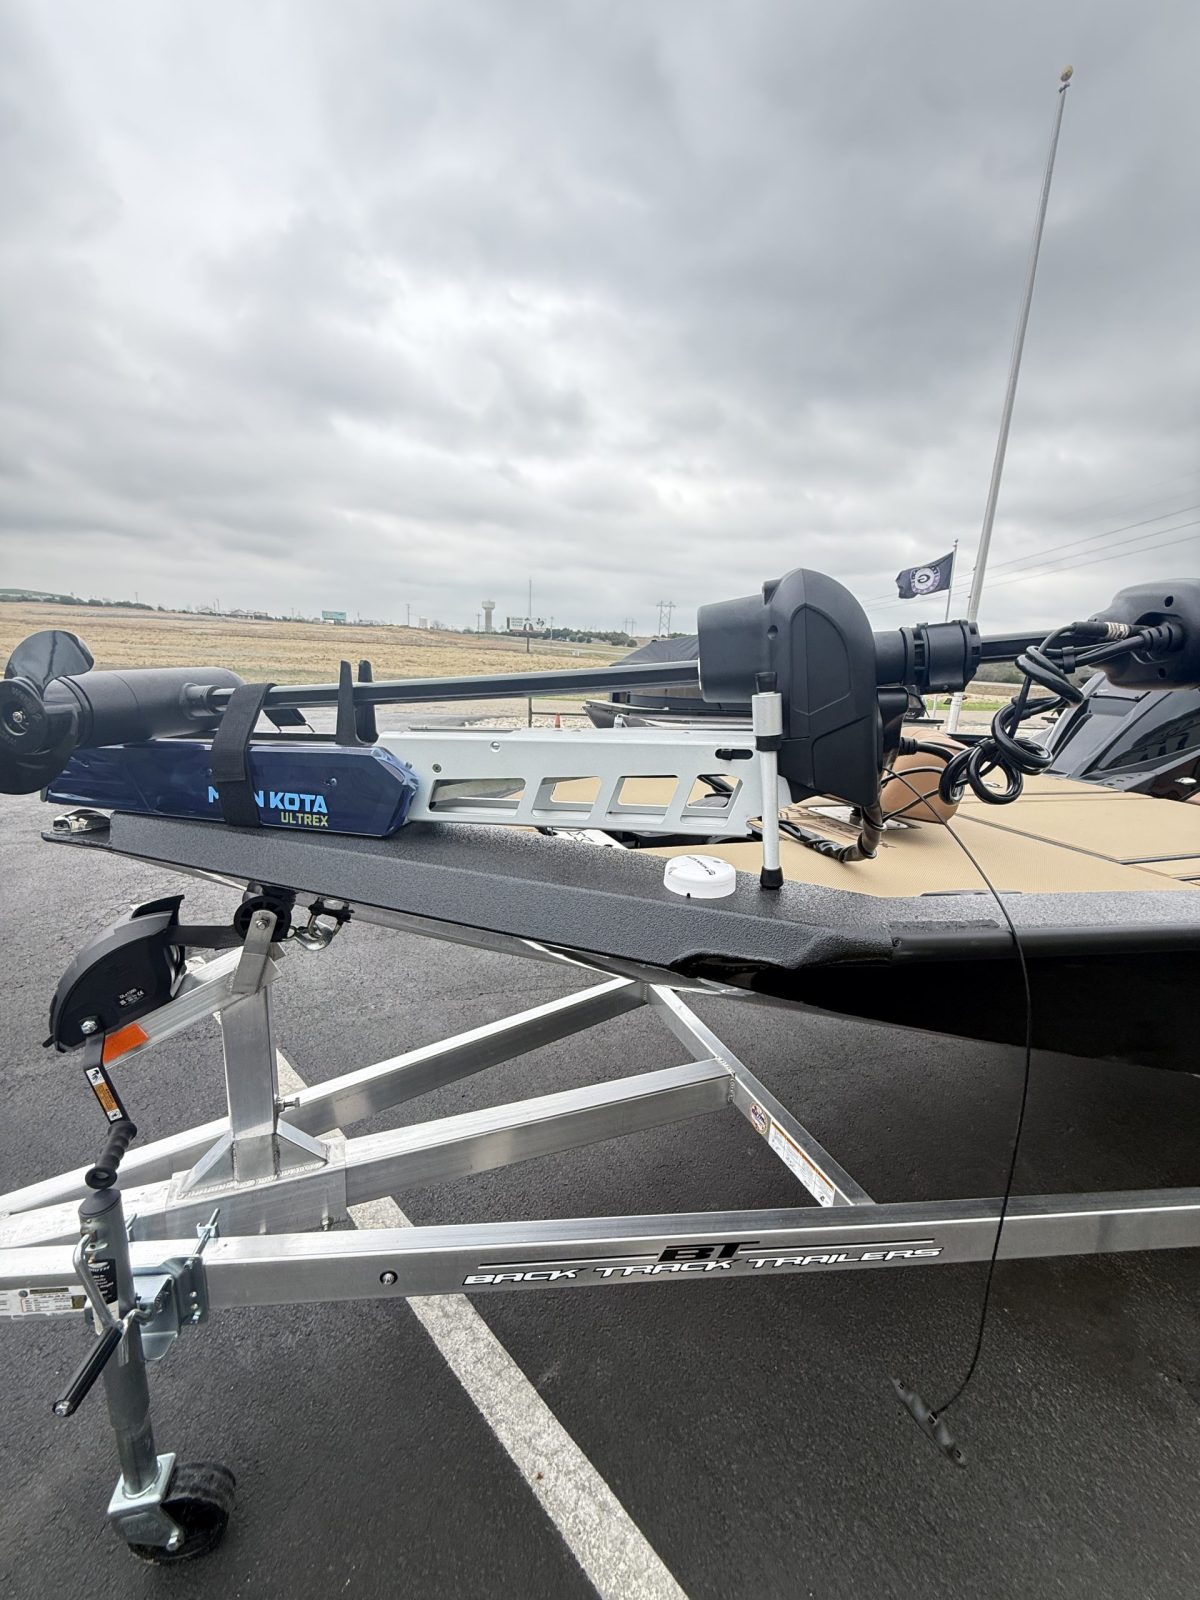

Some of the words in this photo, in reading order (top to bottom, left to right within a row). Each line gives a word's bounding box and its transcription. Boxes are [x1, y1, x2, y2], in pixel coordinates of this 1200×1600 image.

[208, 786, 265, 808] MN
[269, 791, 328, 813] KOTA
[280, 811, 329, 827] ULTREX
[658, 1241, 760, 1262] BT
[463, 1268, 586, 1286] BACK
[594, 1258, 740, 1280] TRACK
[748, 1247, 943, 1270] TRAILERS
